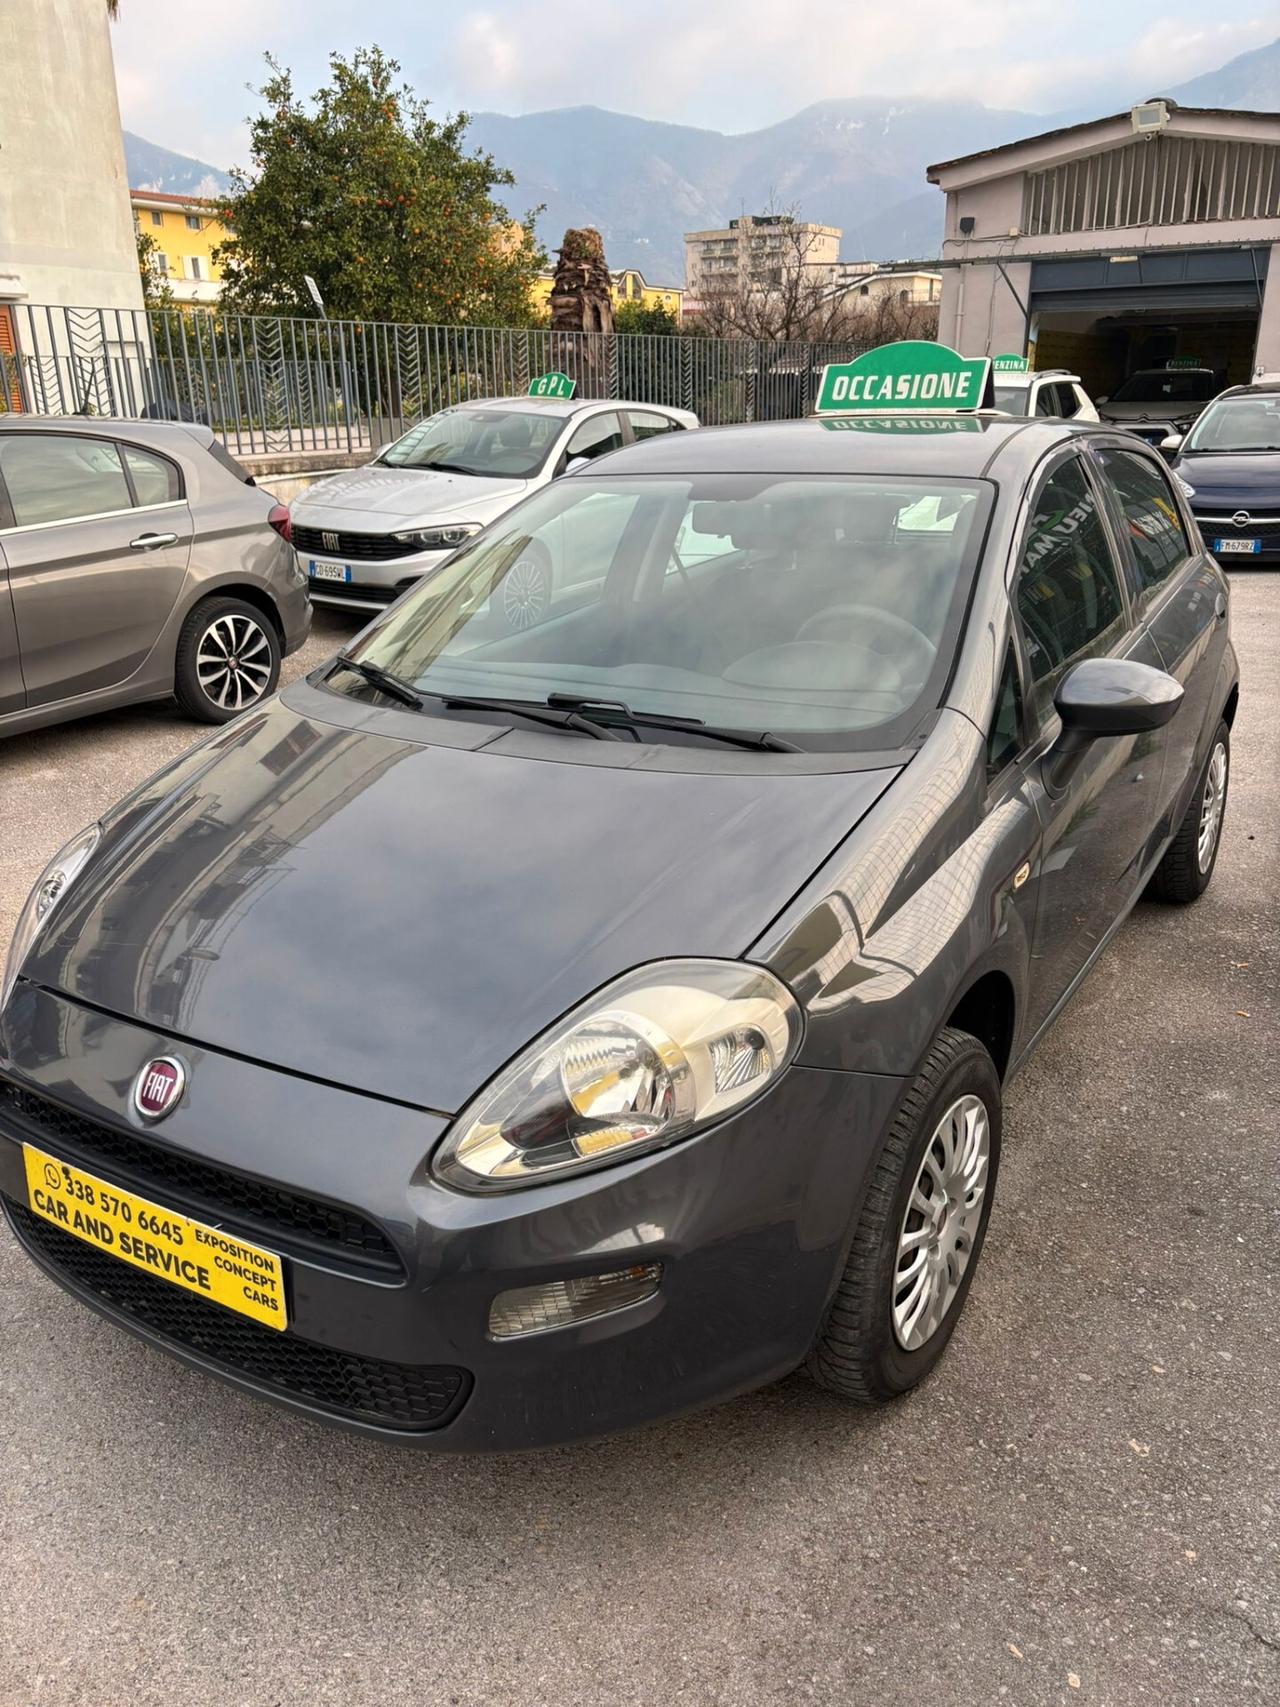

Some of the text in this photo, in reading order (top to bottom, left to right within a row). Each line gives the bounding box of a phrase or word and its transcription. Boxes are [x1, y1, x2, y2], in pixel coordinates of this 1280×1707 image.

[993, 361, 1025, 370] ENZINA
[537, 377, 565, 396] GPL
[836, 372, 972, 400] OCCASIONE
[322, 532, 340, 550] FIAT
[143, 1072, 174, 1104] FIAT
[65, 1180, 184, 1246] 338 570 6645
[33, 1189, 212, 1291] CAR AND SERVICE
[195, 1229, 274, 1273] EXPOSITION
[214, 1255, 276, 1291] CONCEPT
[243, 1286, 278, 1310] CARS
